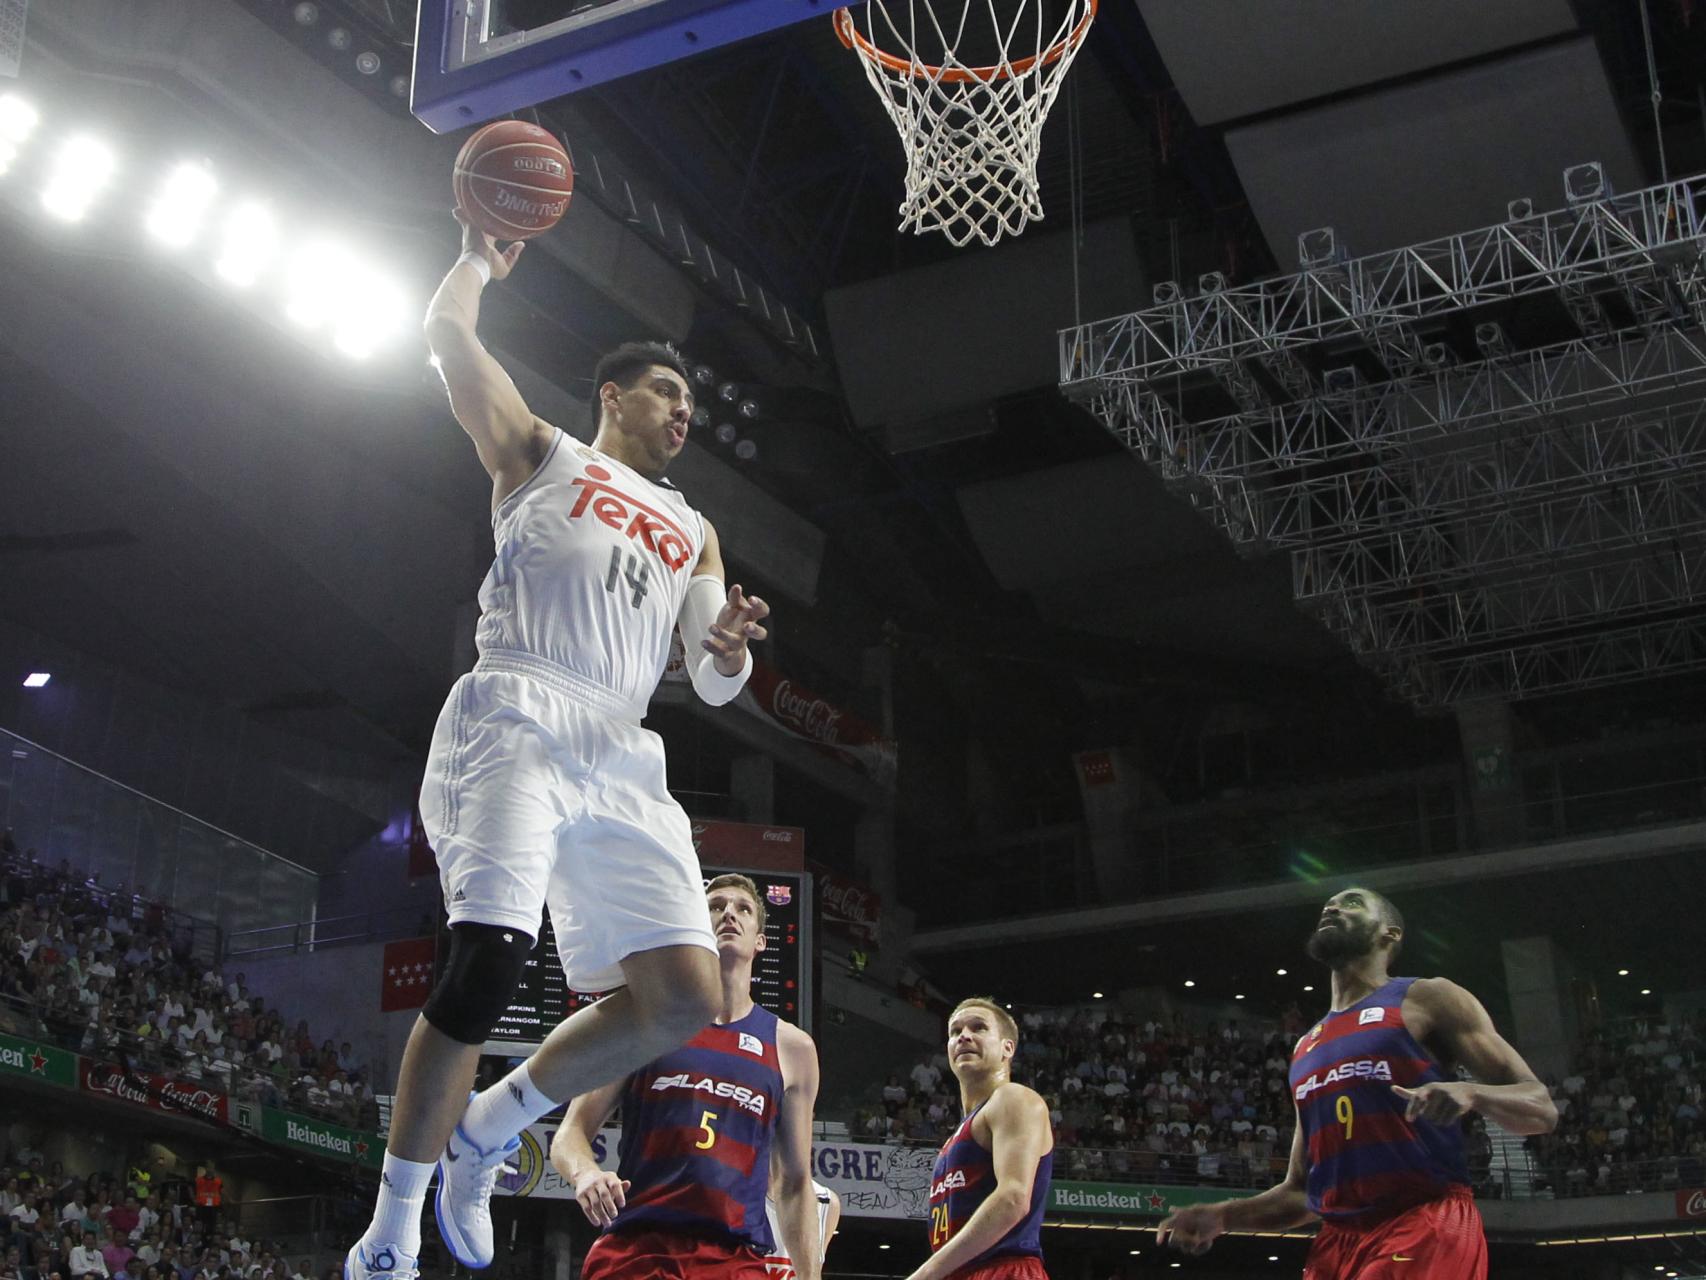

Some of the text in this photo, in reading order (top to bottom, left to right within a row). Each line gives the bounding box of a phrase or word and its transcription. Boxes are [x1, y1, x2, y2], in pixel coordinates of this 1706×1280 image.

[494, 187, 567, 217] SPALDING
[606, 545, 649, 610] 14
[773, 680, 842, 741] Coca-Cola
[762, 830, 793, 842] Coca-Cola
[578, 994, 604, 1002] FALT
[1307, 1060, 1392, 1090] LASSA
[676, 1074, 765, 1113] LASSA
[695, 1110, 718, 1150] 5
[1335, 1095, 1354, 1140] 9
[286, 1120, 351, 1154] Heineken
[1054, 1188, 1141, 1209] Heineken
[931, 1203, 949, 1246] 24
